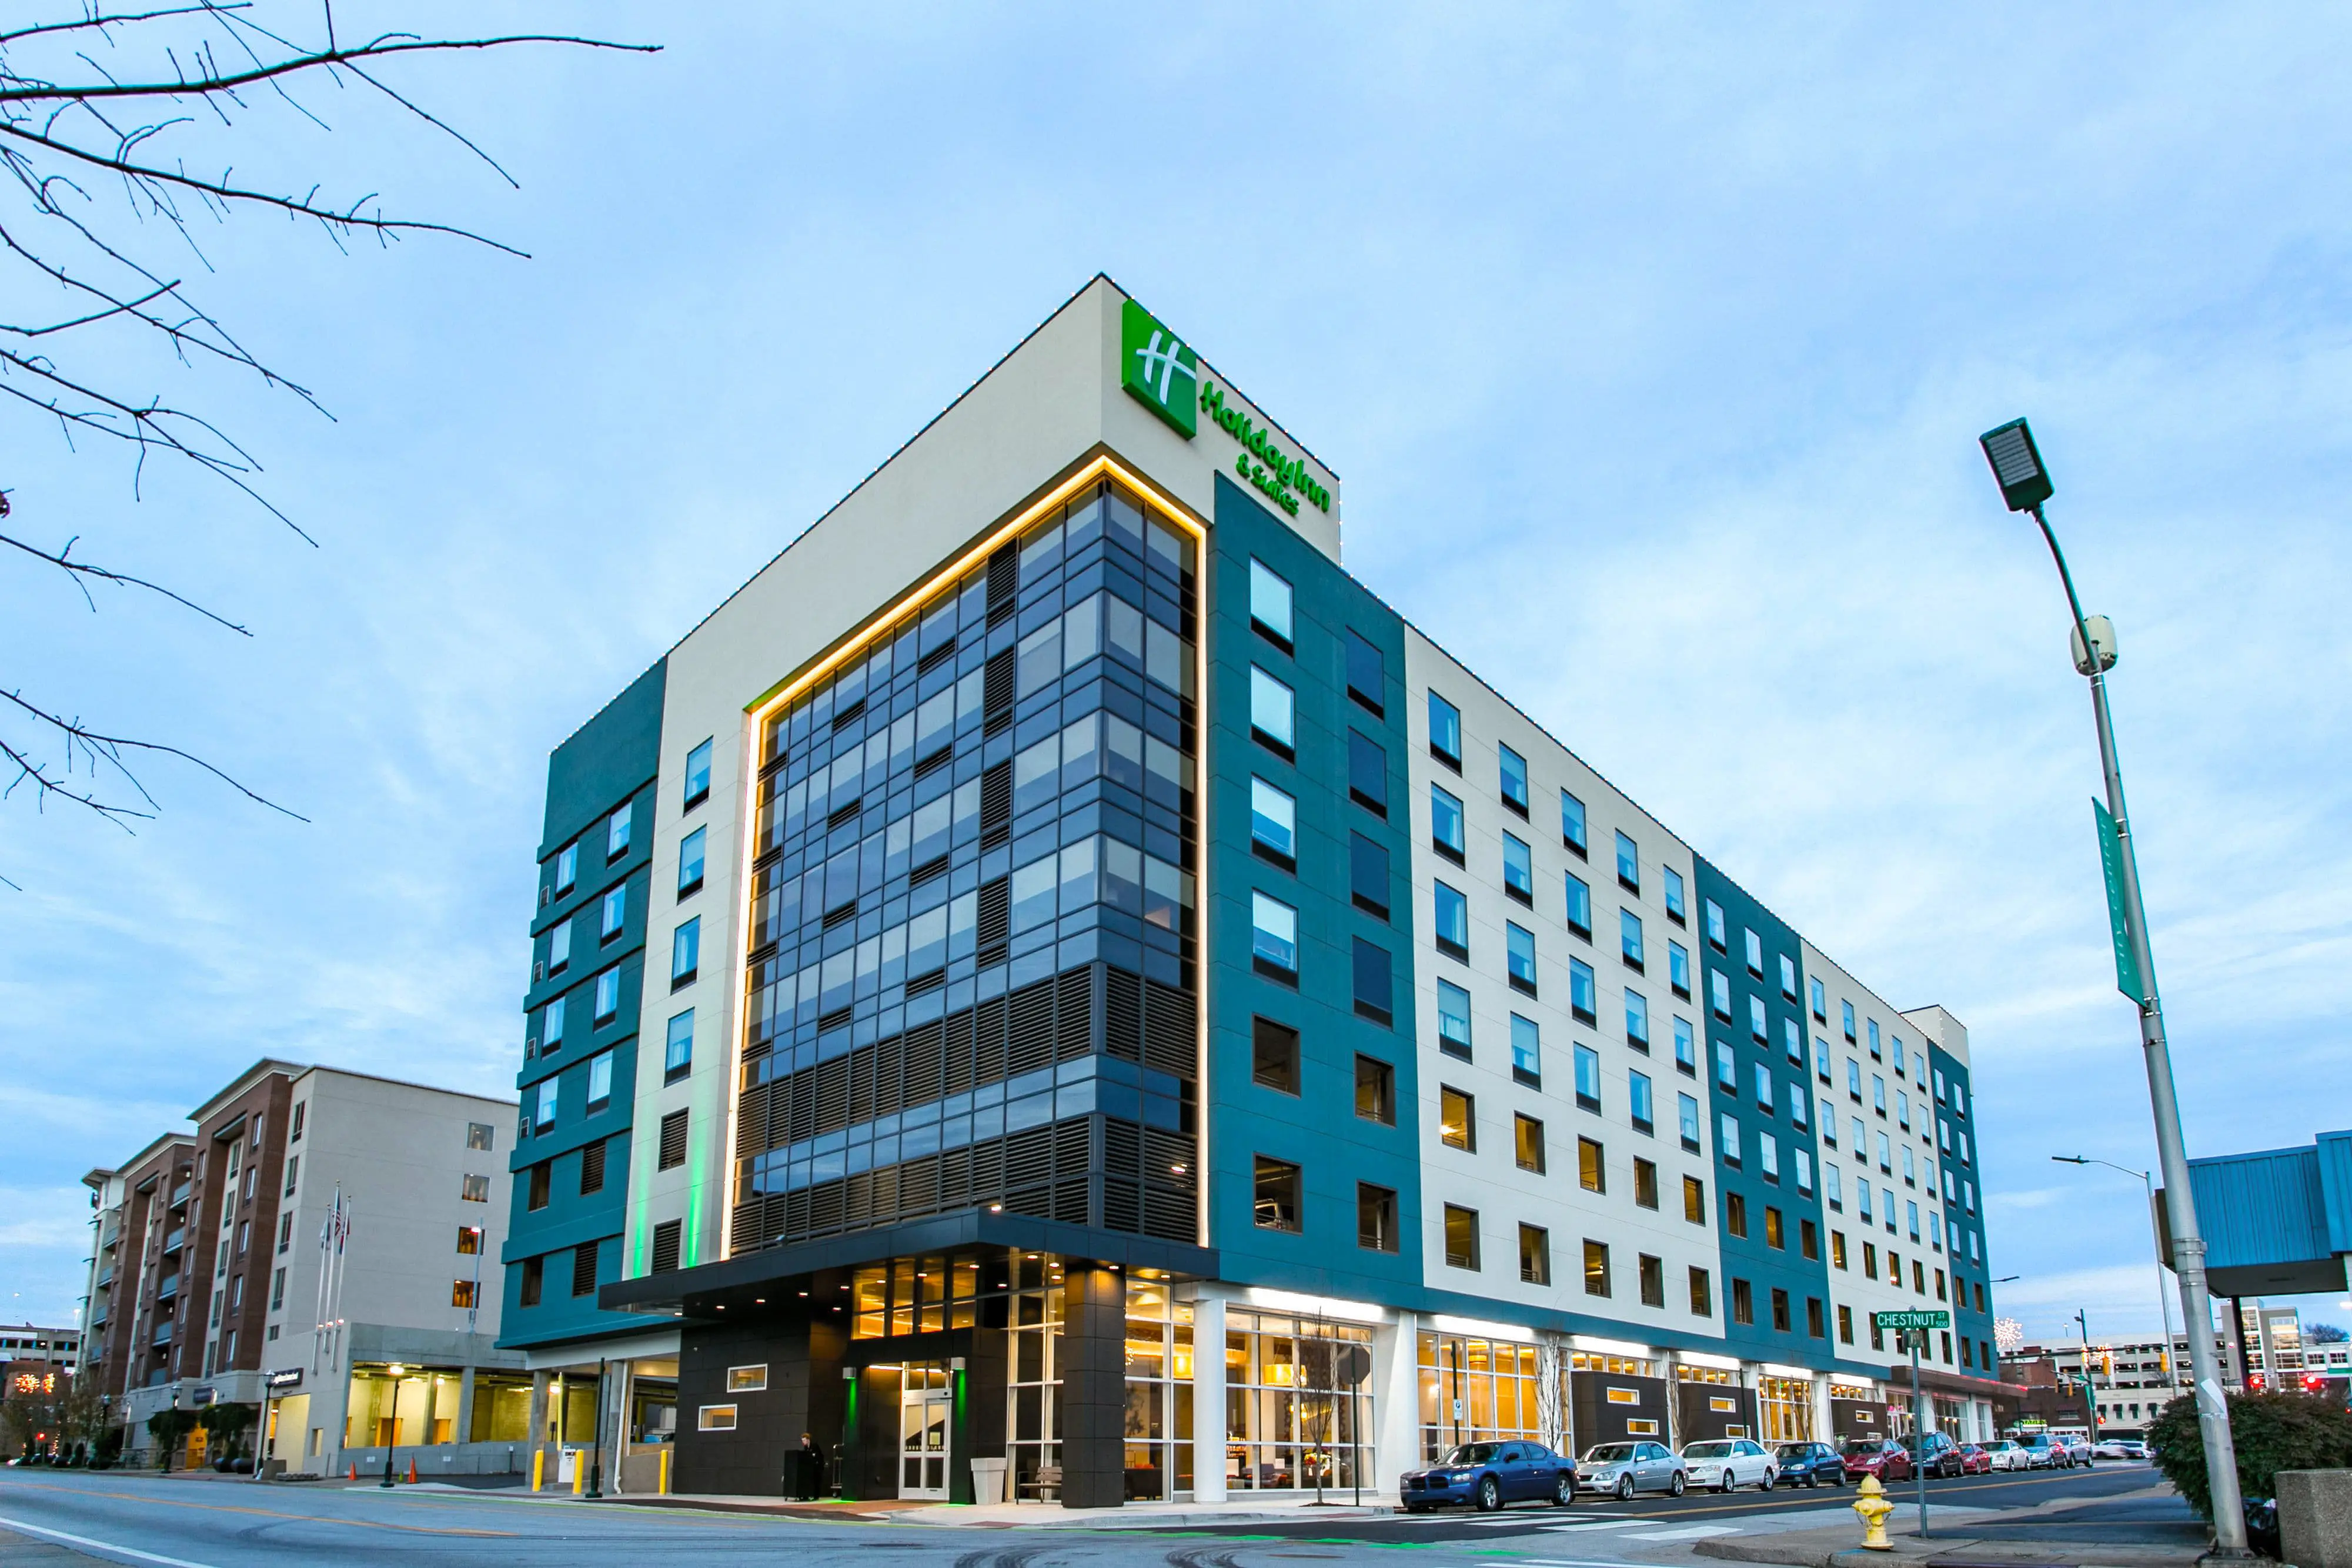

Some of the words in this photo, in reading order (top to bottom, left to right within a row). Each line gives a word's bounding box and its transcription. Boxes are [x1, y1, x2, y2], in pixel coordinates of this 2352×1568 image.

[1236, 453, 1250, 479] &
[1251, 464, 1299, 517] Suites
[1877, 1313, 1935, 1326] CHESTNUT
